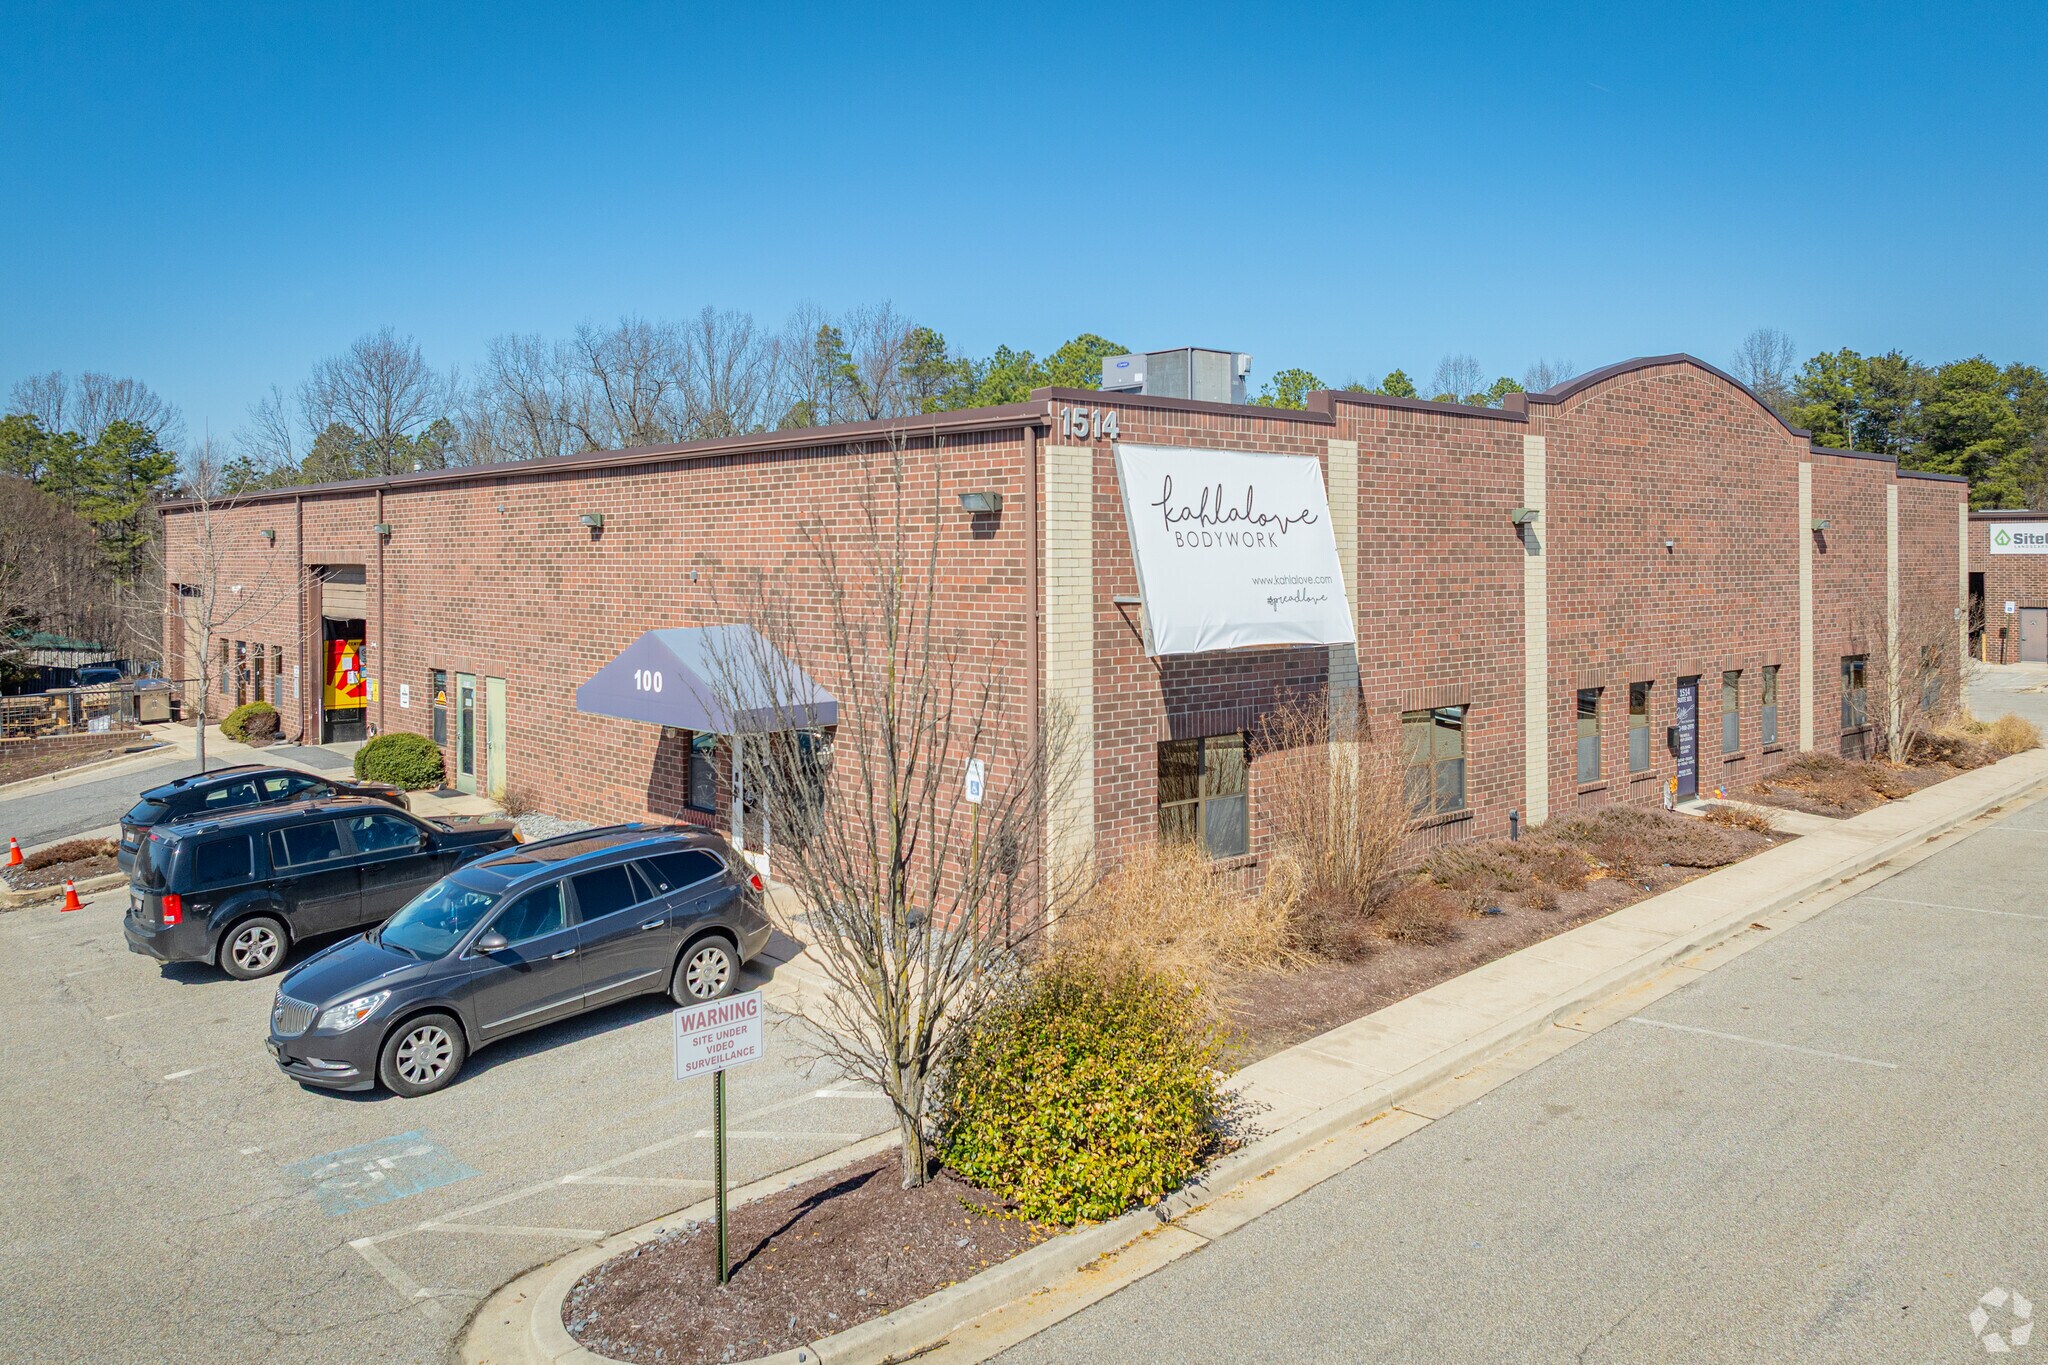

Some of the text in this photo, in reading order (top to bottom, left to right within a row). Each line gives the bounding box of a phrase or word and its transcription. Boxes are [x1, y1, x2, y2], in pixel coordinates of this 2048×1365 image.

[1061, 406, 1120, 440] 1514
[1151, 474, 1319, 535] kahlalove
[1175, 530, 1279, 548] BODYWORK
[1251, 575, 1333, 586] www.kahlalove.com
[634, 669, 662, 693] 100
[681, 999, 756, 1032] WARNING
[693, 1025, 747, 1047] SITE UNDER
[706, 1040, 735, 1054] VIDEO
[686, 1046, 755, 1071] SURVEILLANCE
